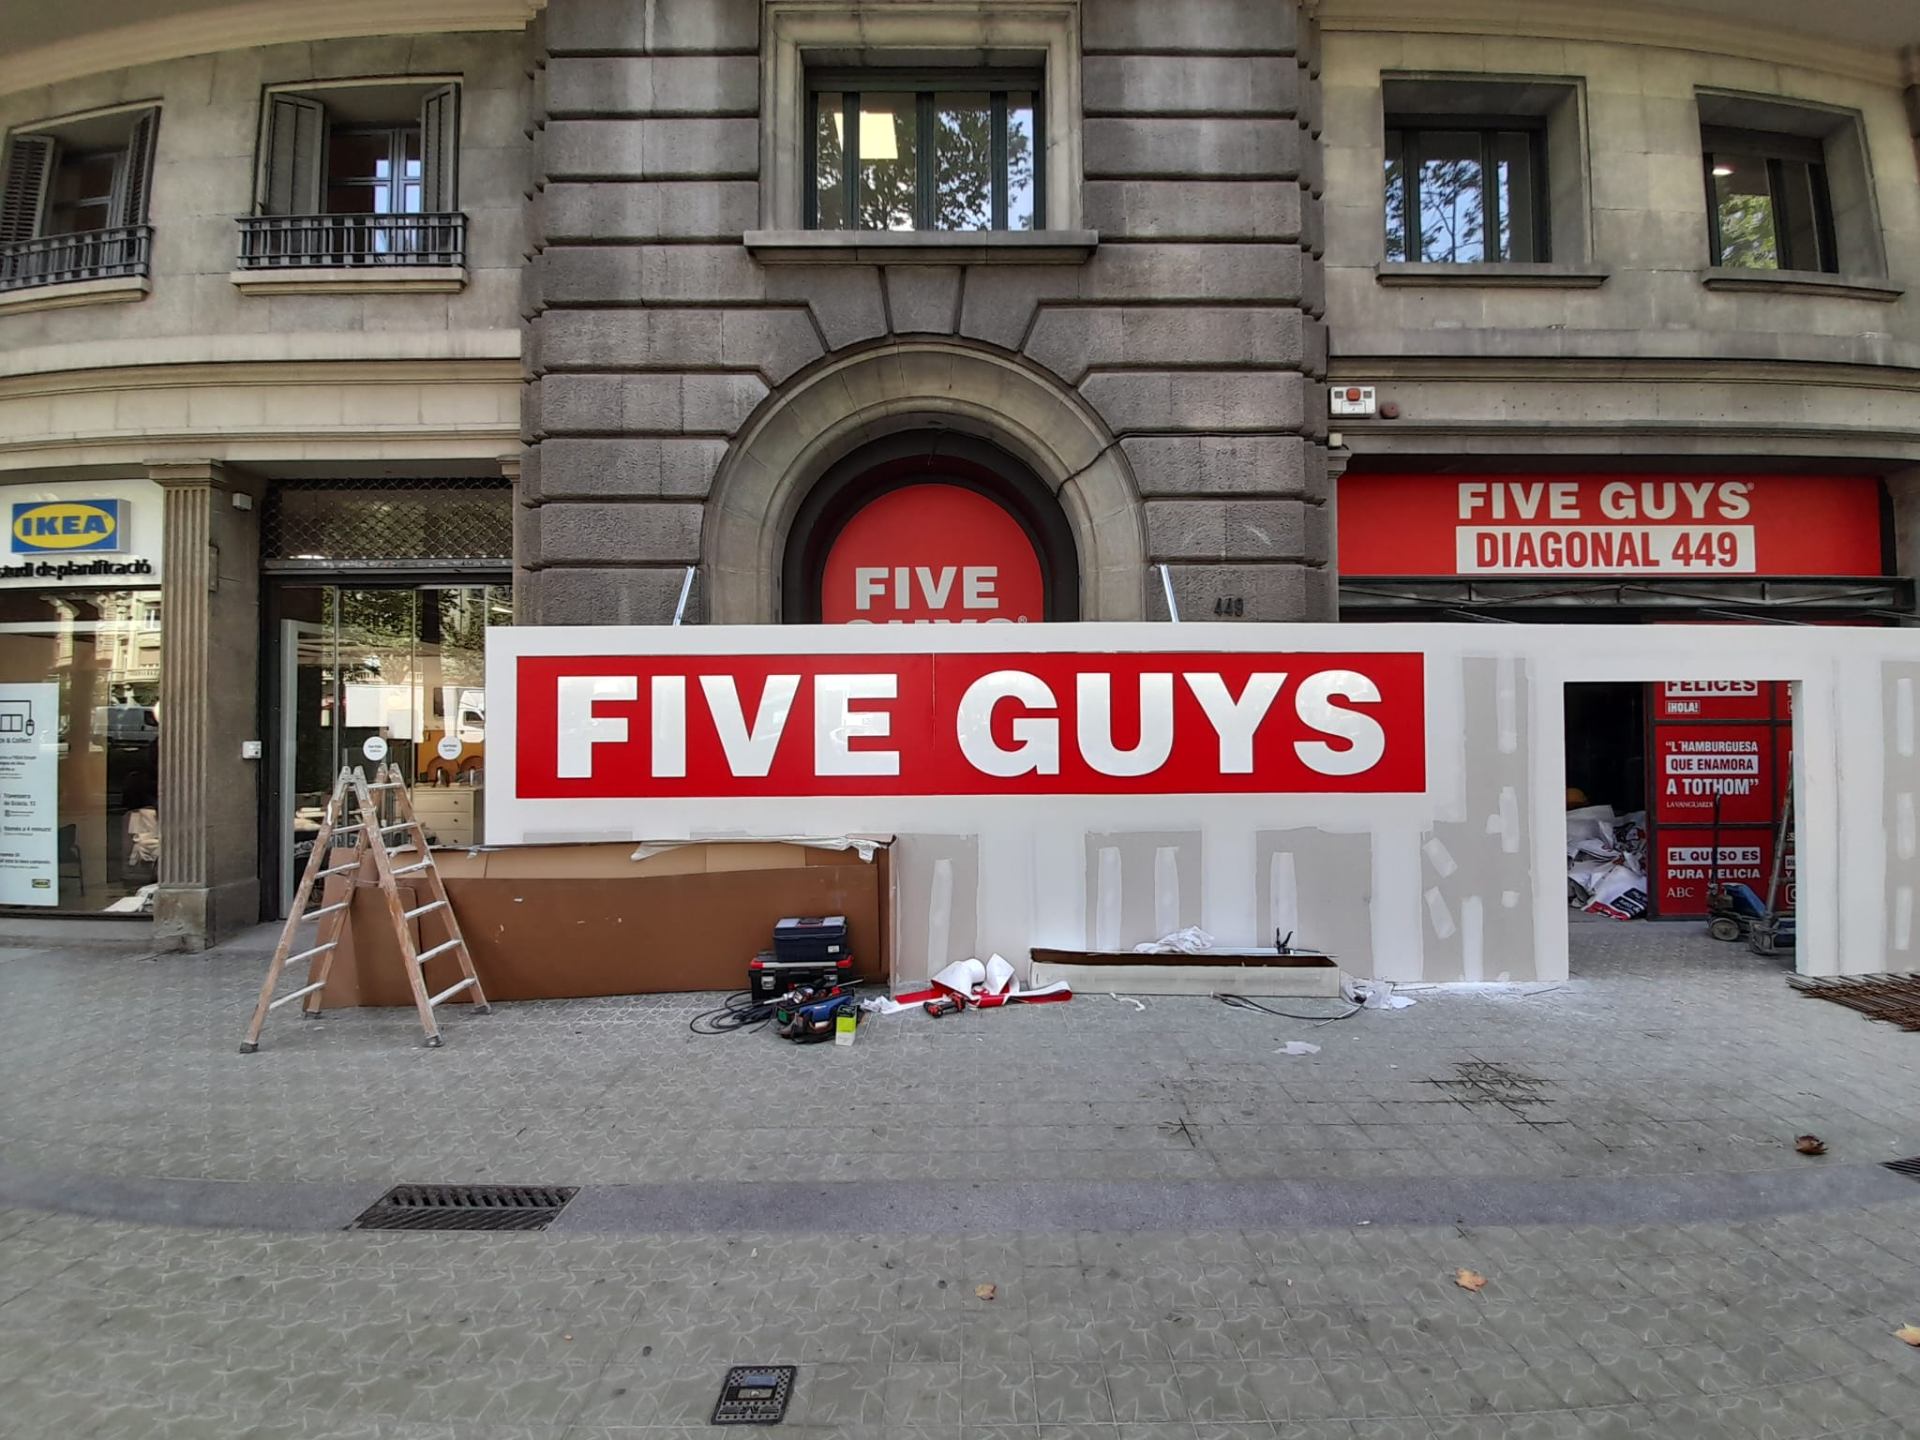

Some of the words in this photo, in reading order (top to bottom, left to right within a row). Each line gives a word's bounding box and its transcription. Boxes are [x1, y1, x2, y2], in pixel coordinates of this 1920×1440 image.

[1458, 482, 1581, 519] FIVE
[1600, 482, 1751, 519] GUYS
[22, 515, 108, 536] IKEA
[1476, 532, 1660, 568] DIAGONAL
[1671, 532, 1738, 567] 449
[36, 561, 57, 577] de
[855, 566, 999, 610] FIVE
[1667, 681, 1756, 692] FELICES
[557, 673, 900, 778] FIVE
[956, 669, 1386, 777] GUYS
[1671, 758, 1693, 771] QUE
[1697, 758, 1754, 770] ENAMORA
[1666, 779, 1678, 795] A
[1669, 851, 1686, 861] EL
[1690, 851, 1737, 862] QUSO
[1742, 851, 1759, 861] ES
[1668, 869, 1704, 879] PURA
[1667, 887, 1694, 898] ABC
